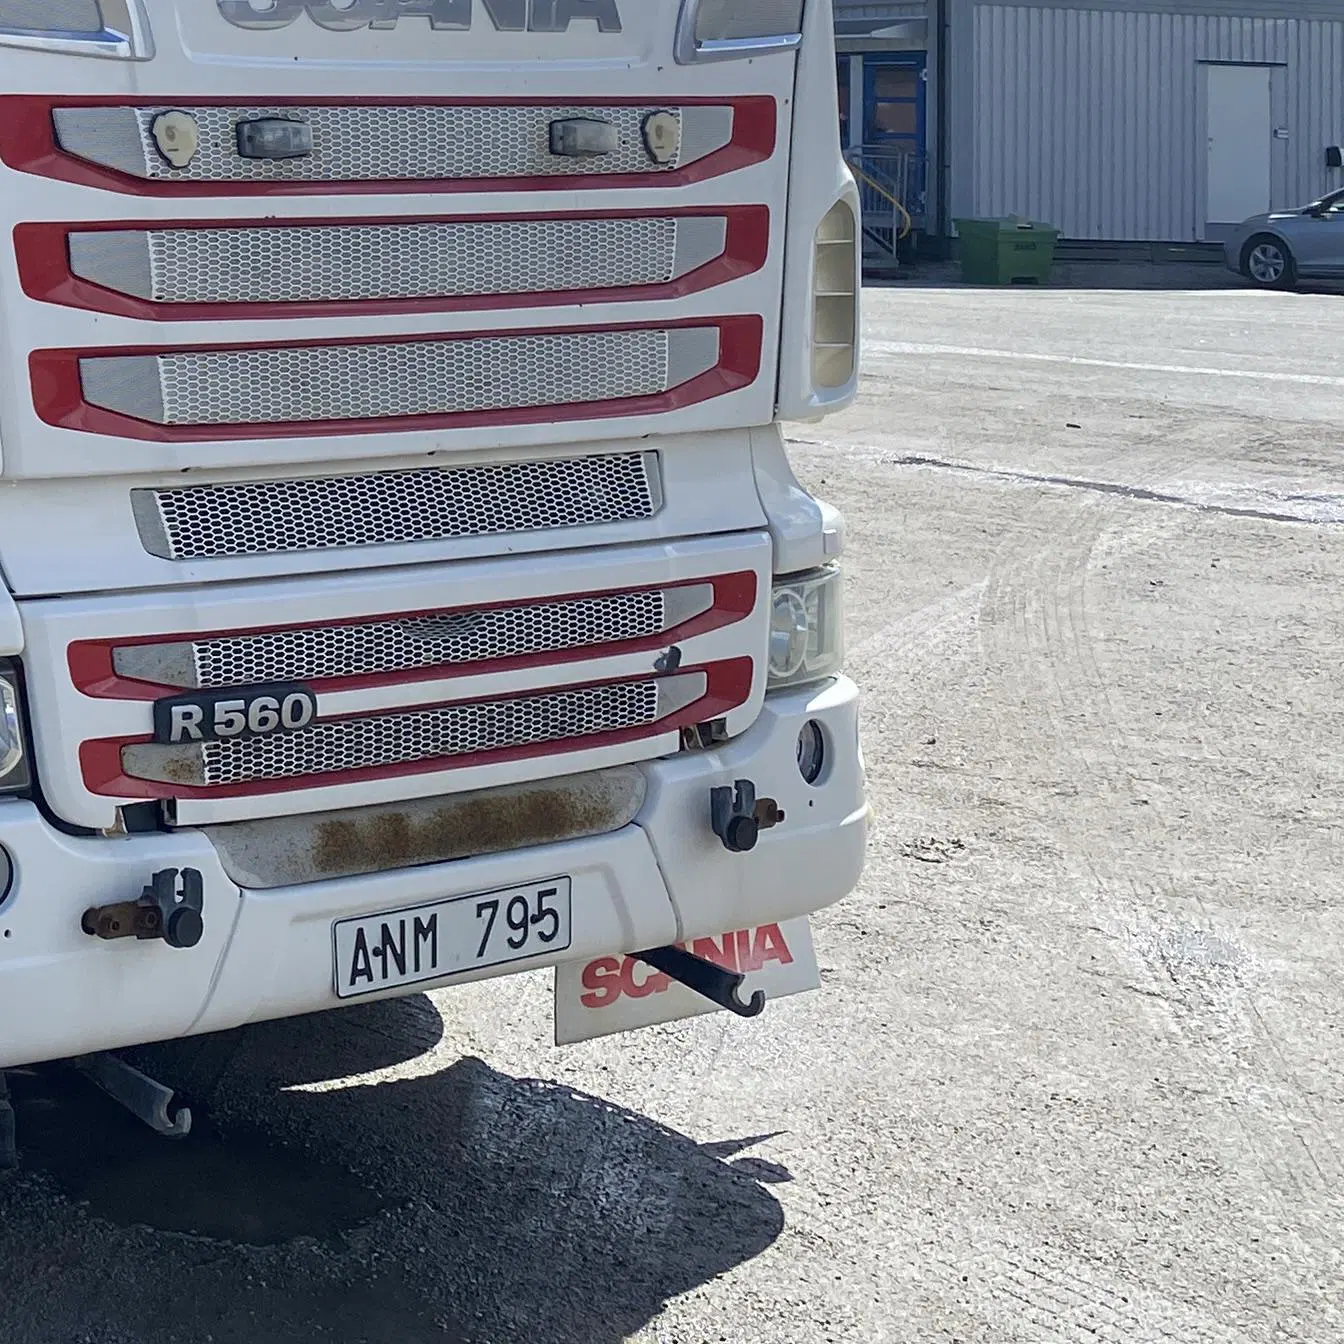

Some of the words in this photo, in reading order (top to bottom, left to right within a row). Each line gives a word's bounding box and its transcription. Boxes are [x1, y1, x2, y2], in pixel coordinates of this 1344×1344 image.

[170, 704, 204, 742] R
[213, 692, 313, 736] 560
[349, 913, 438, 987] ANM
[475, 888, 560, 958] 795
[580, 922, 794, 1009] SCNIA
